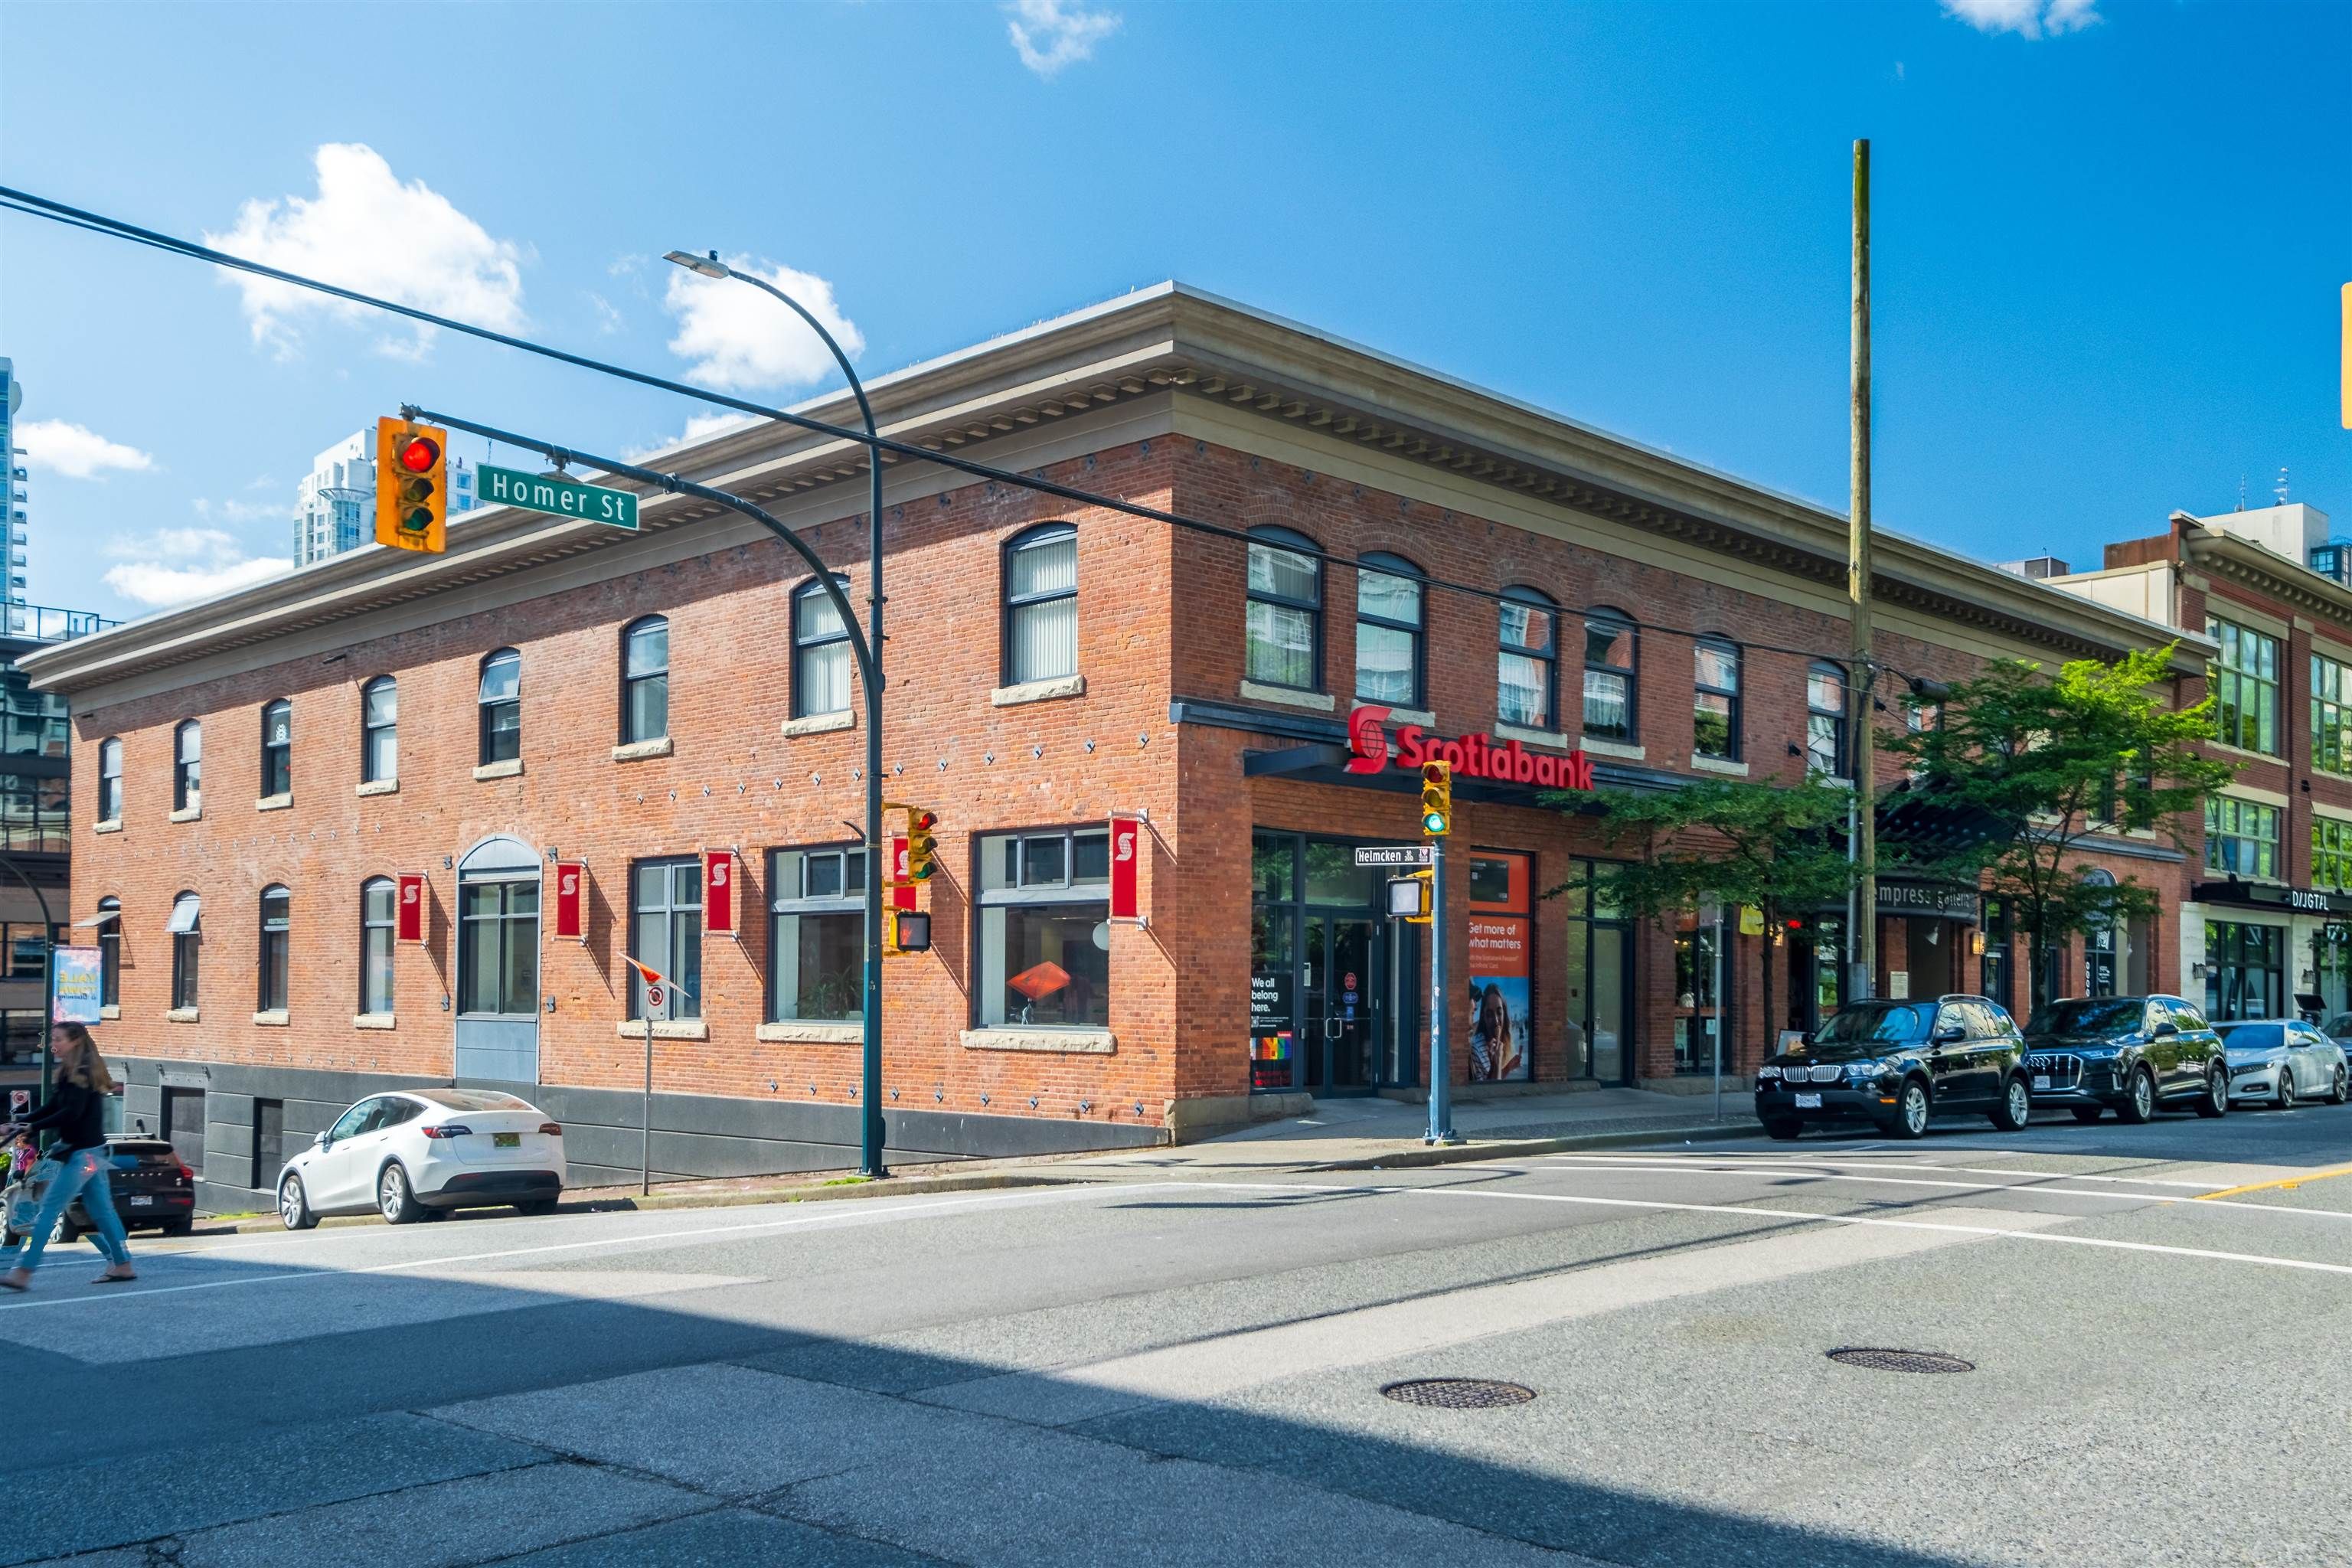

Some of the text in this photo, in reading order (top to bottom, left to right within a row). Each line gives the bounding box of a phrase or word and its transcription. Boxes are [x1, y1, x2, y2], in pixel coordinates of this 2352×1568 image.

[493, 473, 624, 521] Homer St
[1396, 724, 1595, 791] Scotiabank
[1358, 849, 1401, 862] Helmcken
[1484, 925, 1505, 935] more
[1507, 924, 1516, 936] of
[1489, 939, 1521, 949] matters
[1251, 978, 1275, 988] We all
[1251, 990, 1279, 1002] belong
[1251, 1002, 1271, 1012] here.
